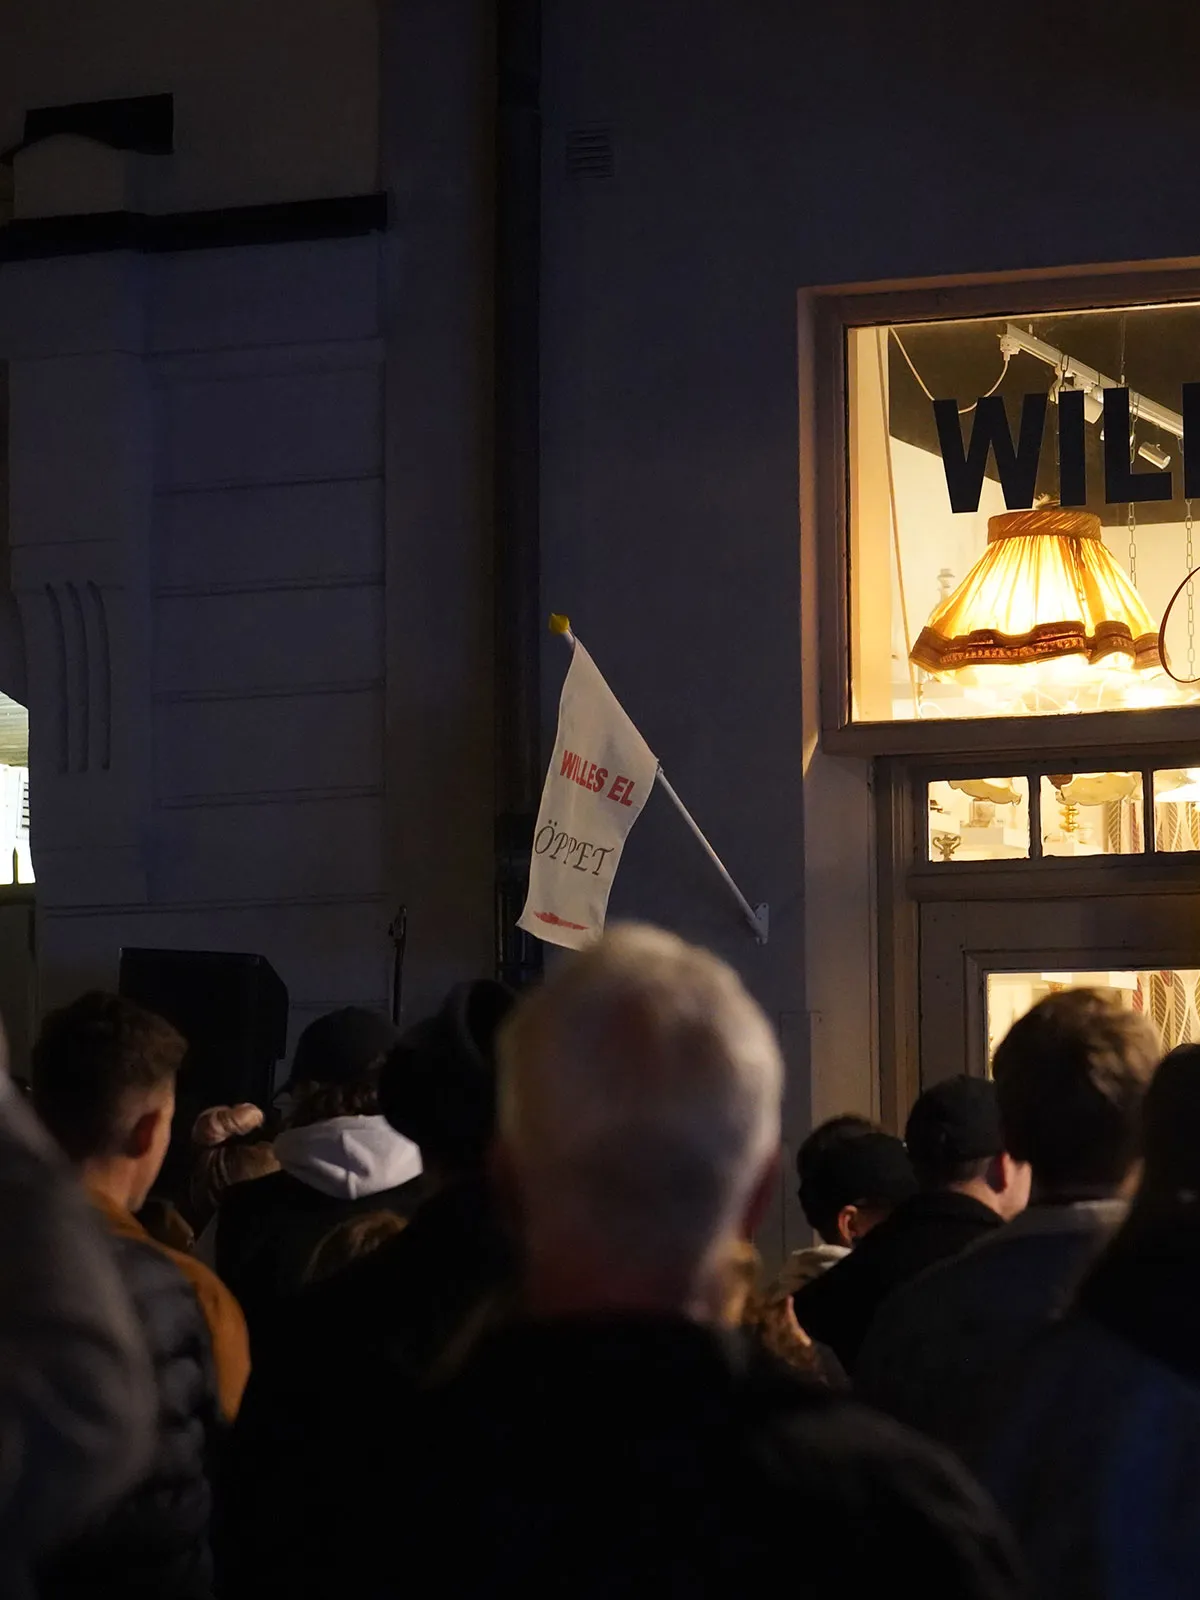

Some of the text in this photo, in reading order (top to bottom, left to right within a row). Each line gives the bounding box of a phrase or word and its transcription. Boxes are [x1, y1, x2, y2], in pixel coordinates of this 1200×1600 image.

[560, 749, 636, 807] WILLES EL
[533, 819, 615, 876] ÖPPET
